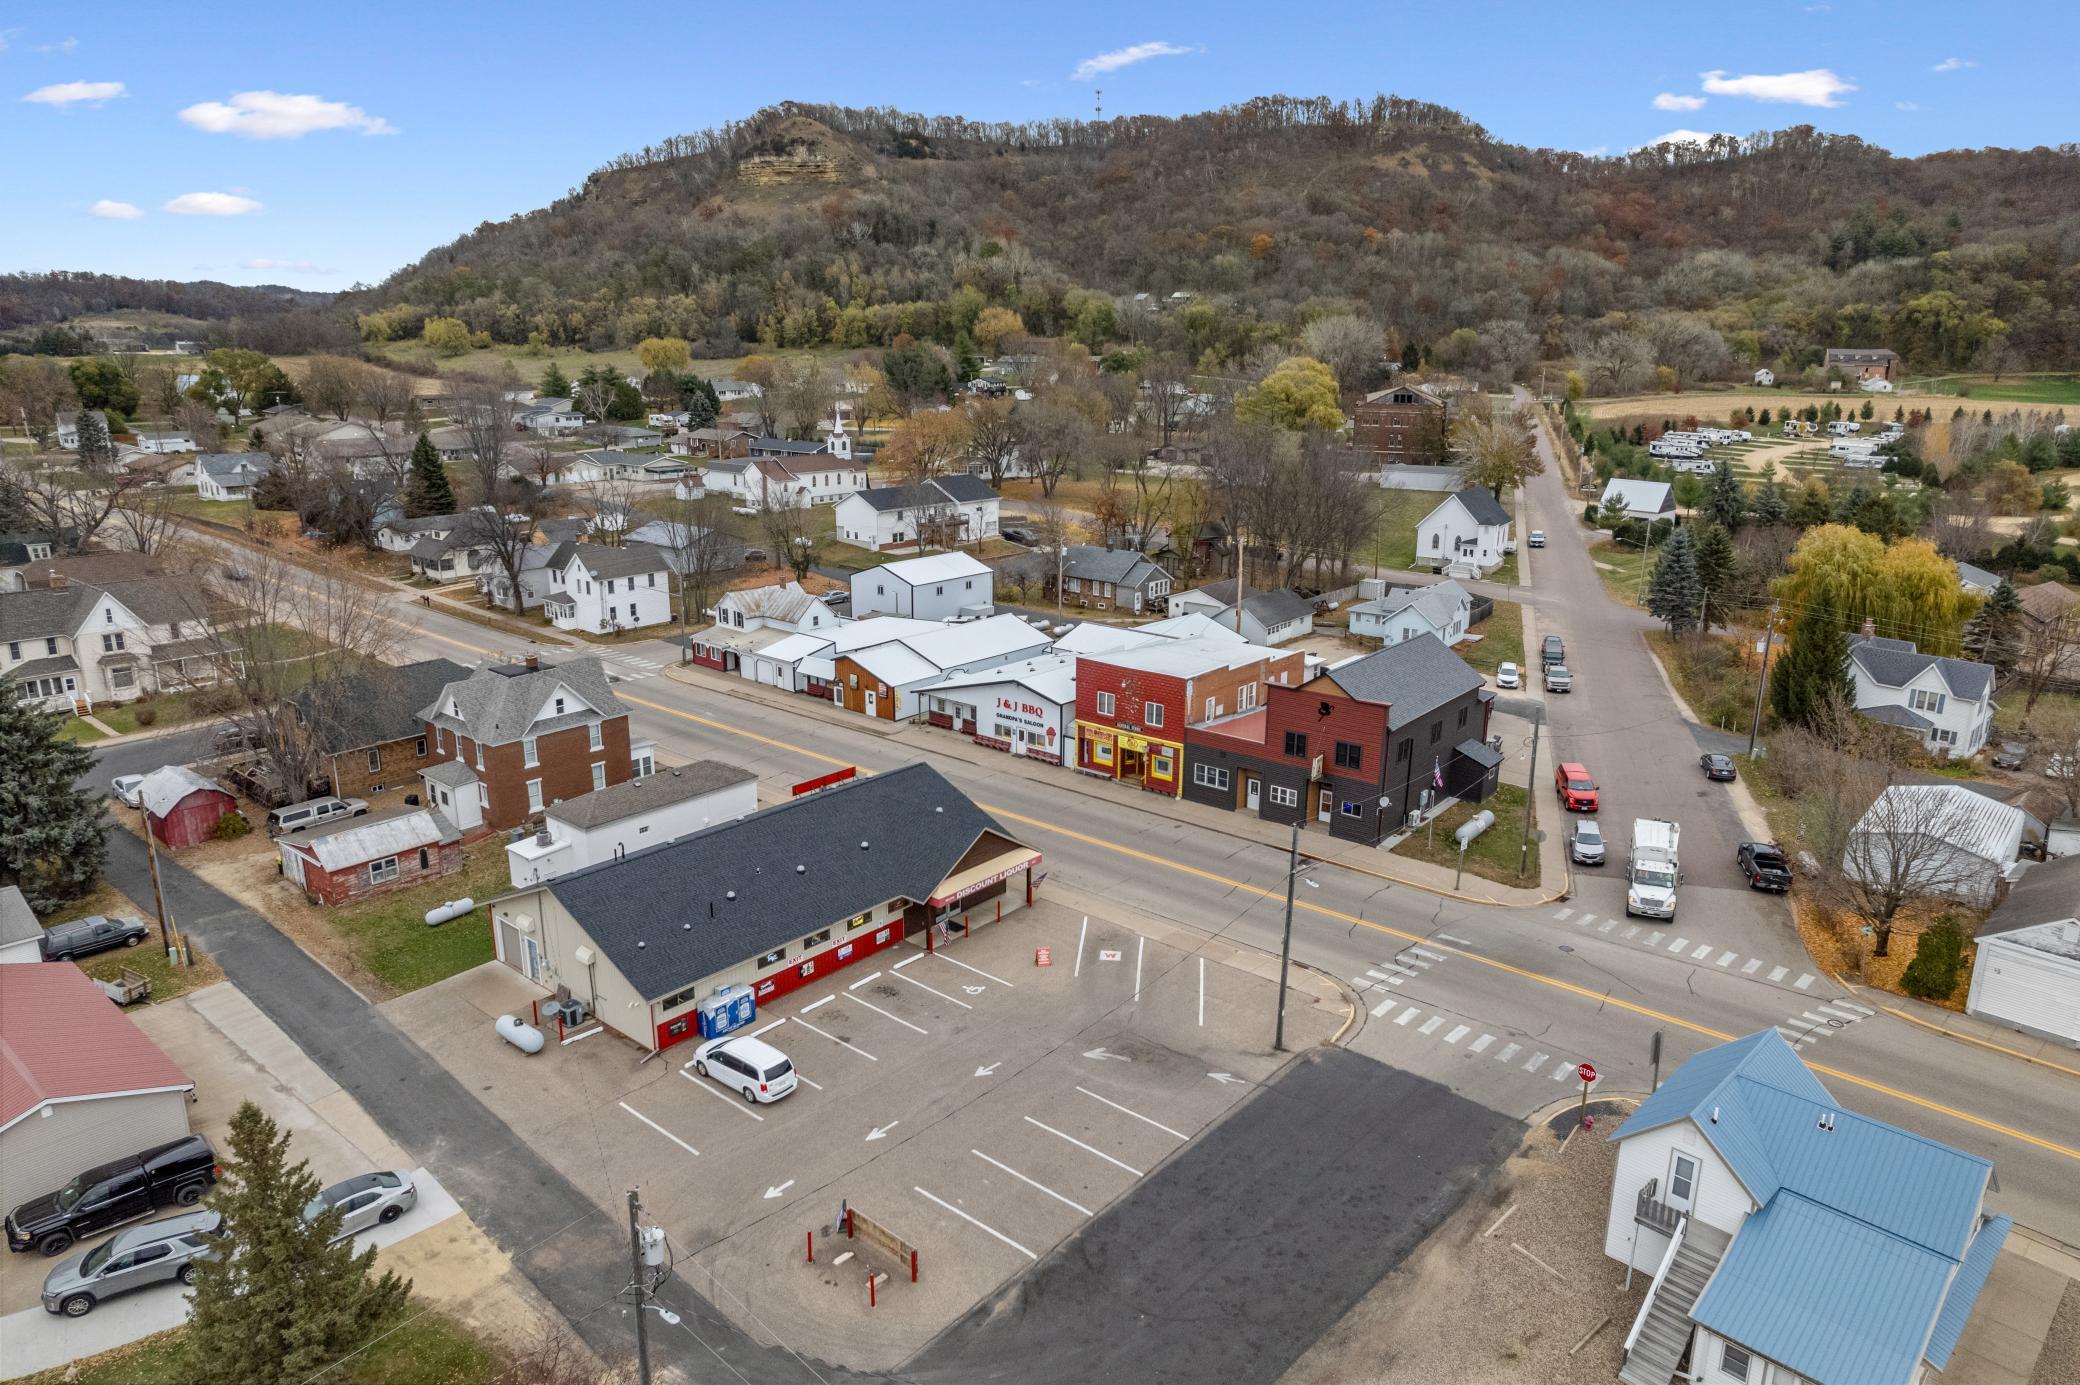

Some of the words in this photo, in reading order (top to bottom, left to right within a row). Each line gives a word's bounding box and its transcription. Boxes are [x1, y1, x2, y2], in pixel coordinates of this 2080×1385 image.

[996, 697, 1000, 708] J
[1003, 699, 1012, 710] &
[1013, 701, 1018, 712] J
[1021, 703, 1043, 719] BBQ
[996, 712, 1023, 723] GRANDPA'S
[1023, 719, 1044, 728] SALOON
[956, 876, 998, 900] DISCOUNT
[999, 861, 1029, 881] LIQUOR
[832, 936, 845, 946] EXIT
[788, 954, 802, 965] EXIT
[1578, 1066, 1596, 1078] STOP
